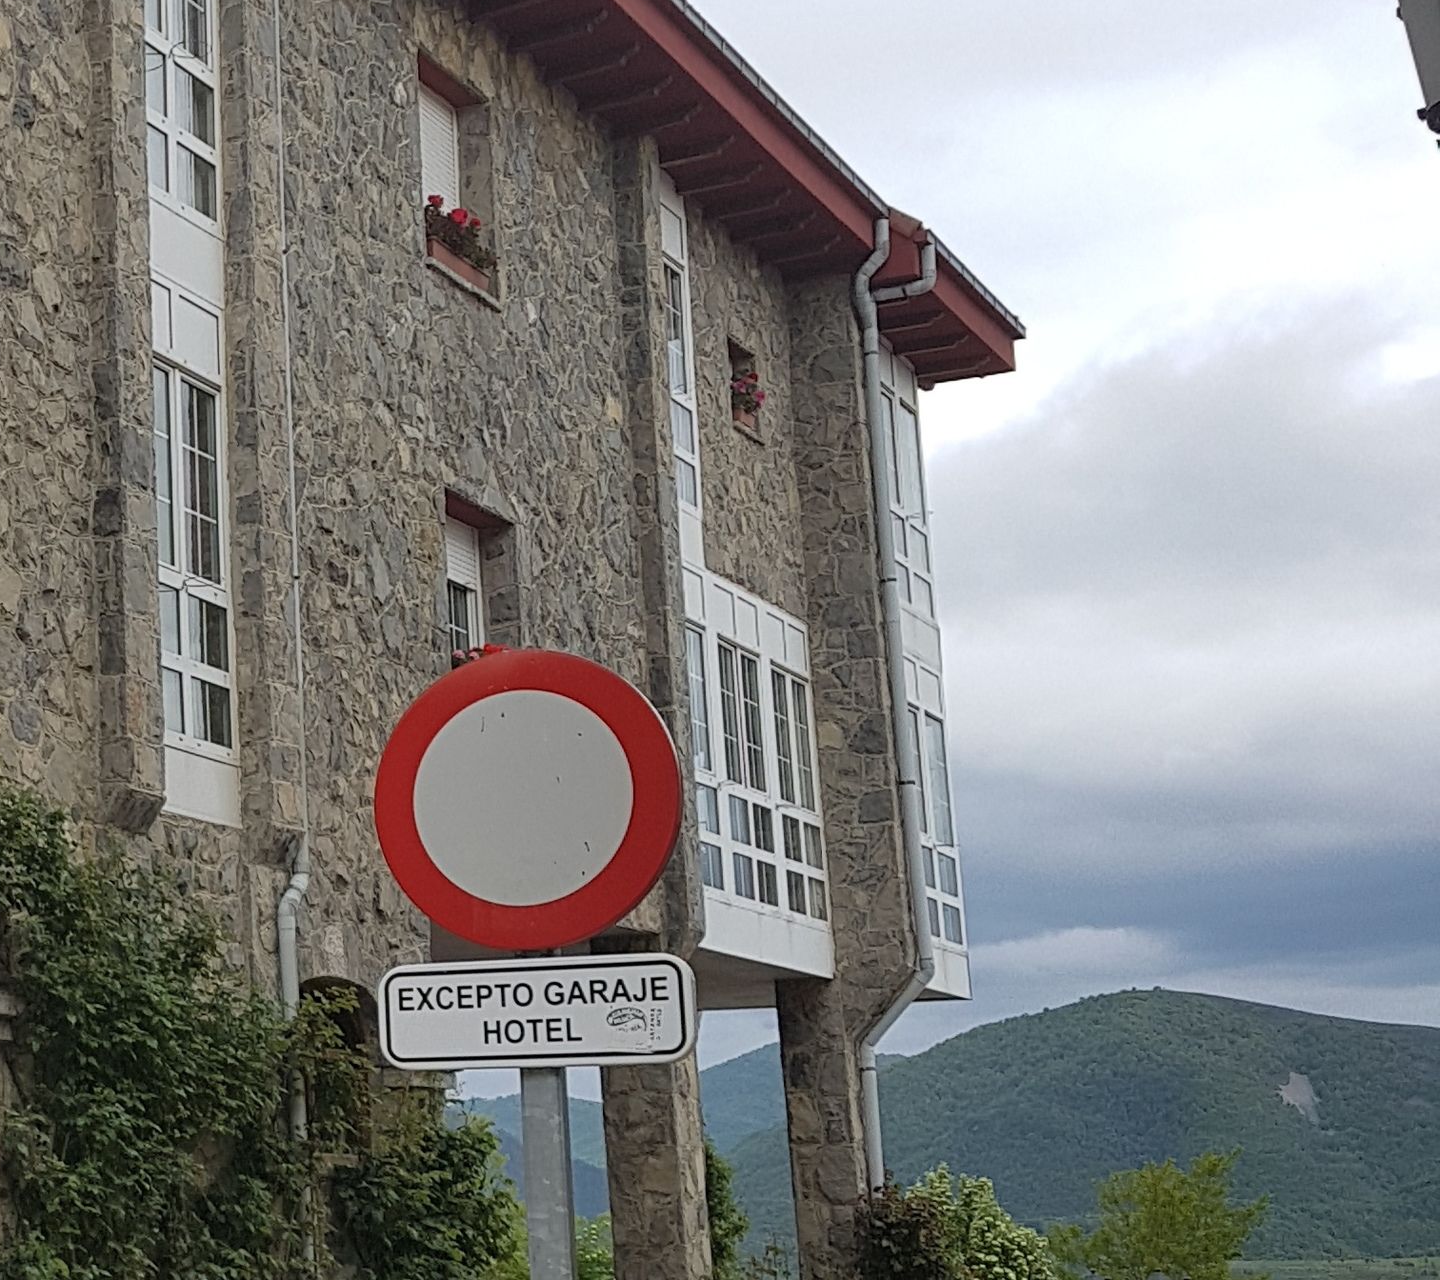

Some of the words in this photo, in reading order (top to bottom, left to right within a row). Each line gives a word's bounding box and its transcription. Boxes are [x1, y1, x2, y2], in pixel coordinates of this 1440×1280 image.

[398, 982, 533, 1011] EXCEPTO
[544, 976, 670, 1006] GARAJE
[483, 1018, 582, 1045] HOTEL
